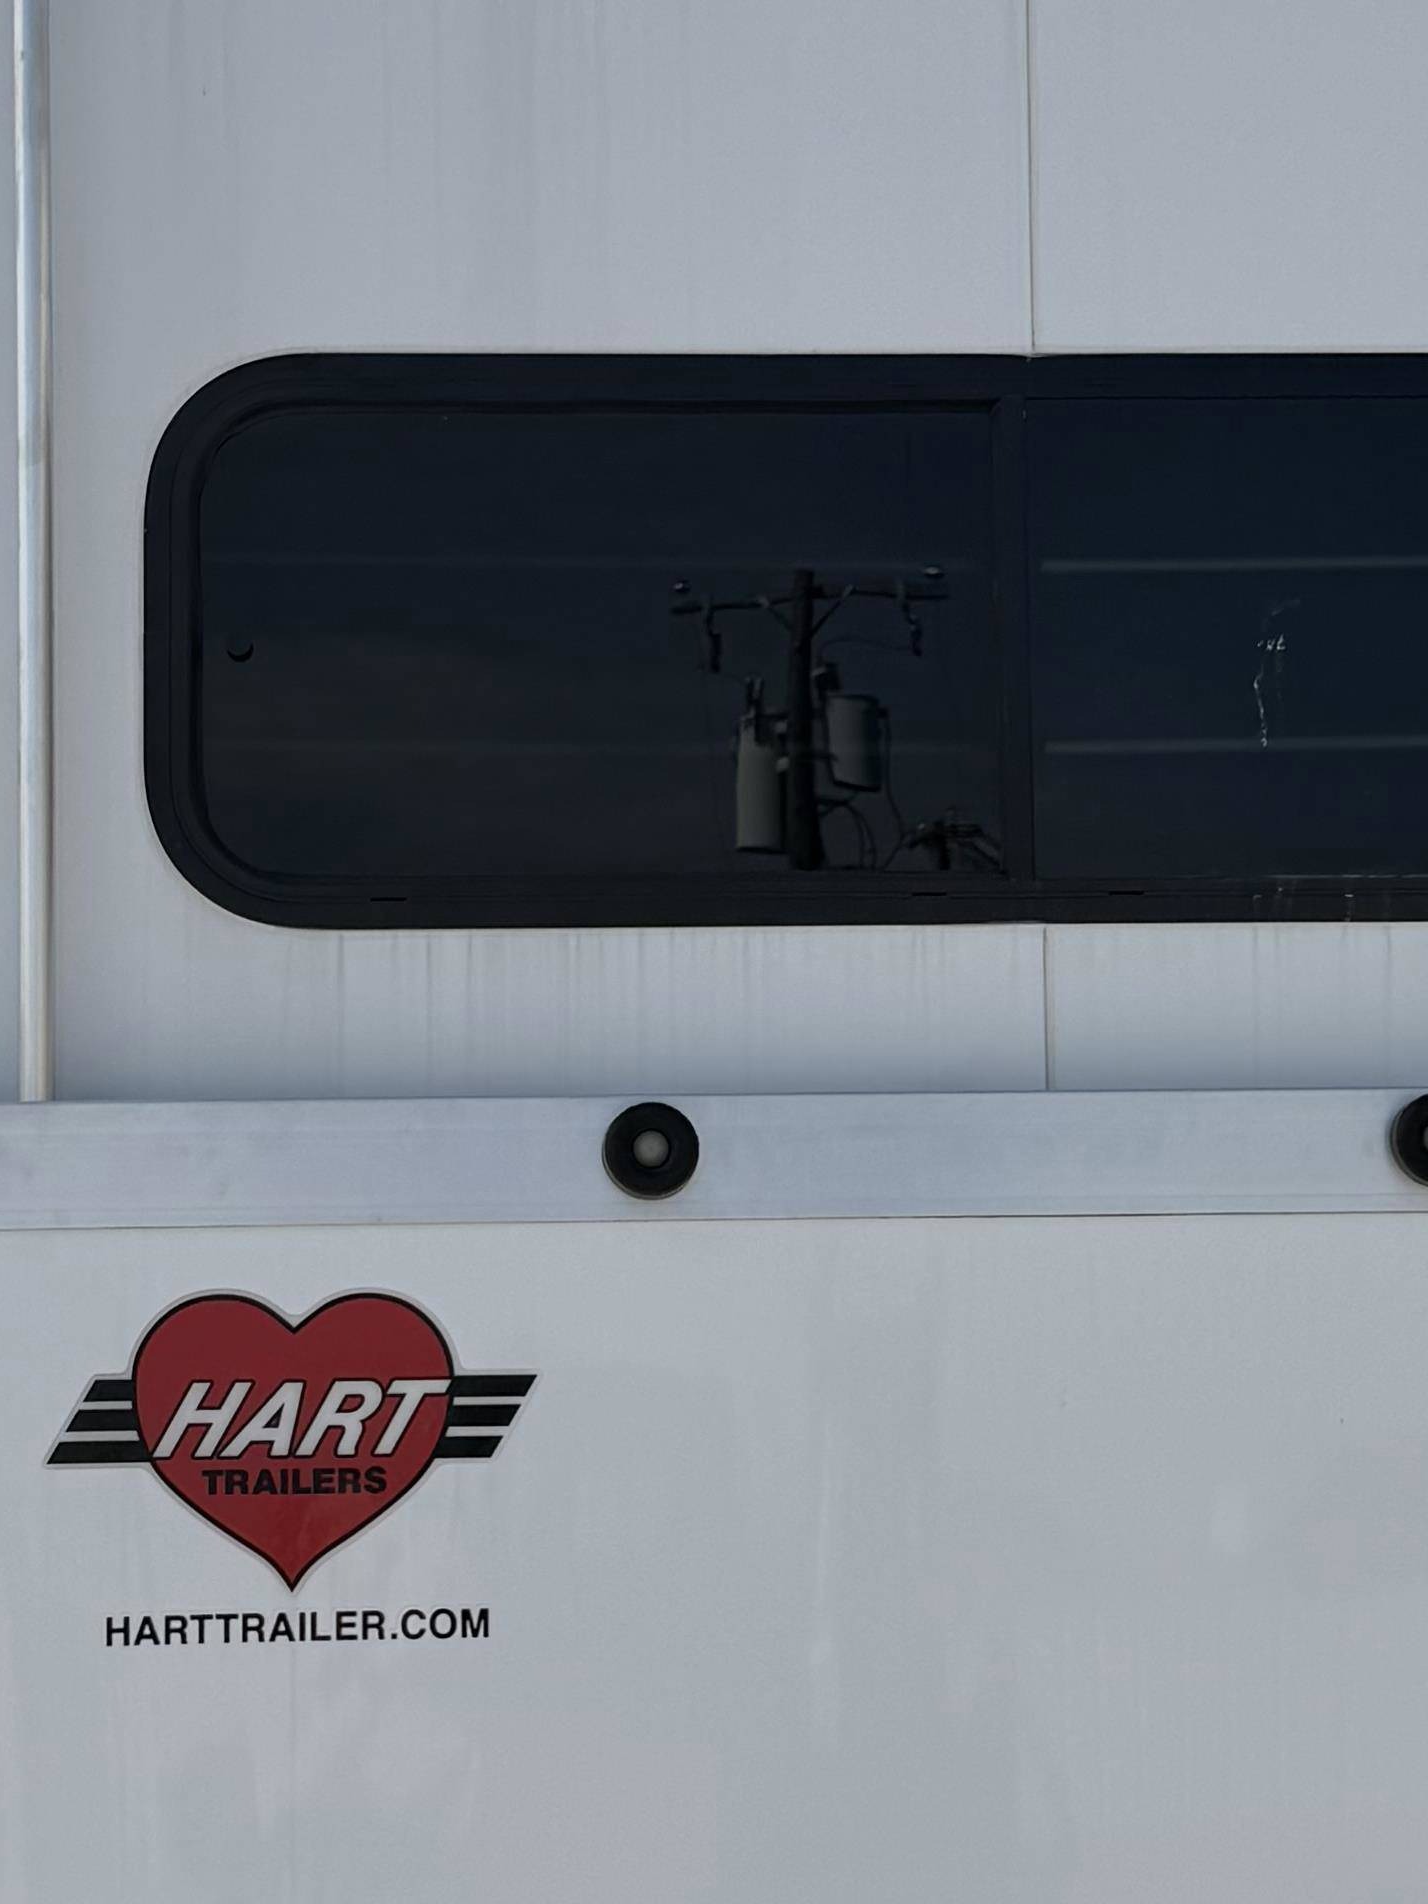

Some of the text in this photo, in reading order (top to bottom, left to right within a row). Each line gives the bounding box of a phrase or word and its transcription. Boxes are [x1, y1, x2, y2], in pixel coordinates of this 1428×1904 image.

[153, 1379, 451, 1458] HART
[202, 1467, 388, 1495] TRAILERS
[105, 1607, 490, 1647] HARTTRAILER.COM
